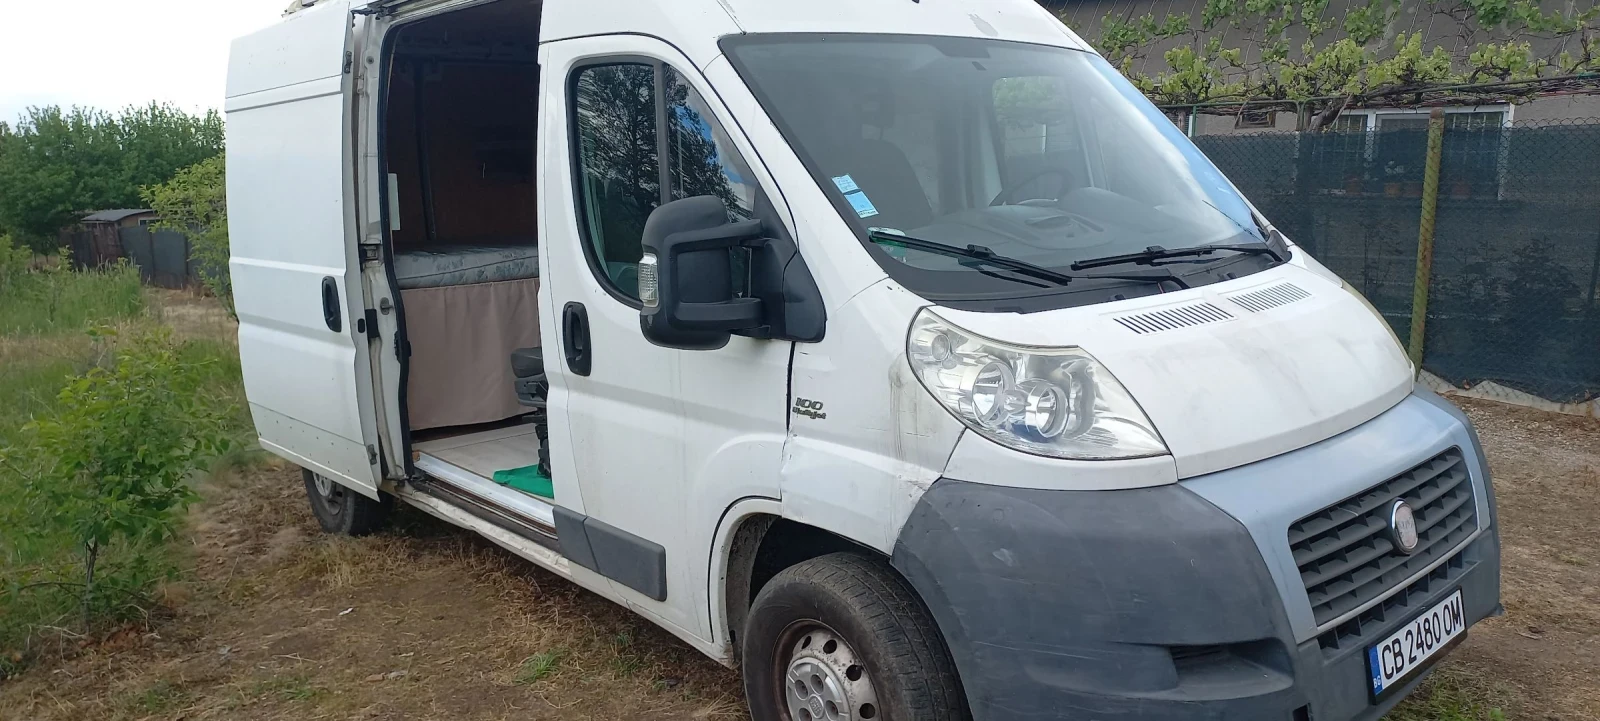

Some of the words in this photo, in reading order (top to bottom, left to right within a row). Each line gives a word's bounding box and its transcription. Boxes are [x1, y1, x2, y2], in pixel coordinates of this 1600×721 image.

[796, 397, 824, 411] 100
[1381, 638, 1404, 680] CB
[1405, 611, 1441, 666] 2480
[1443, 596, 1462, 637] OM
[1373, 675, 1382, 689] BG
